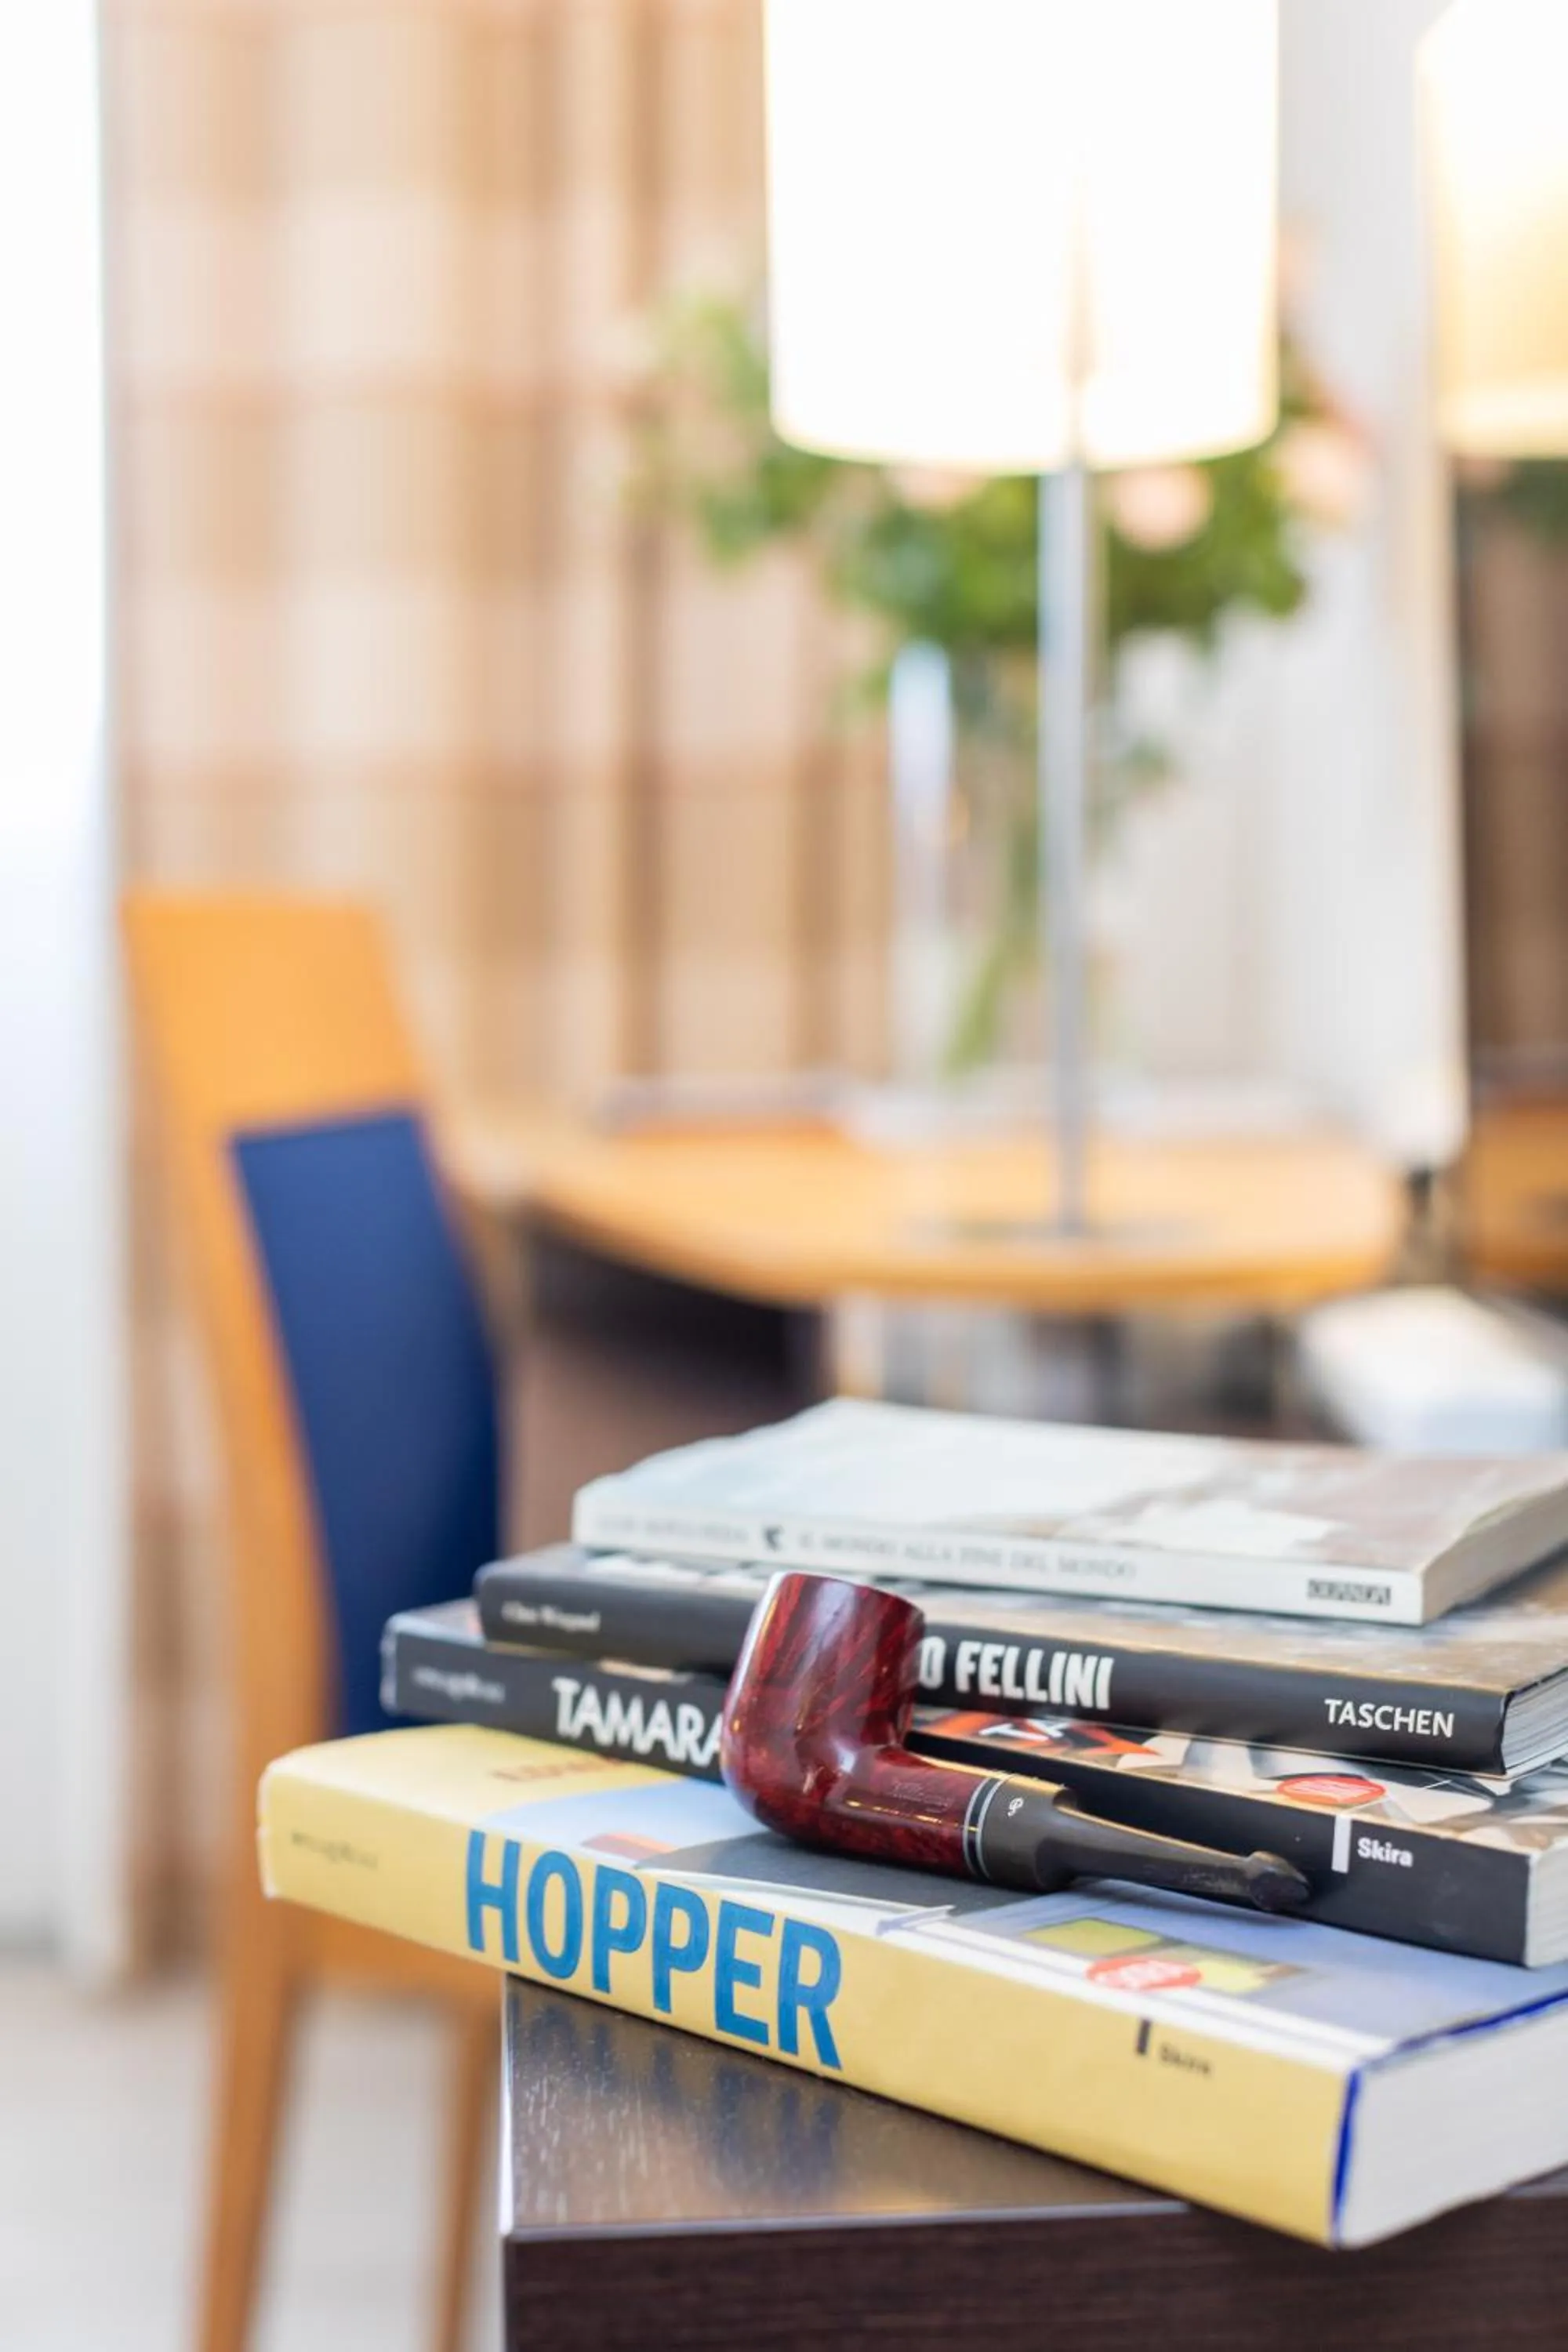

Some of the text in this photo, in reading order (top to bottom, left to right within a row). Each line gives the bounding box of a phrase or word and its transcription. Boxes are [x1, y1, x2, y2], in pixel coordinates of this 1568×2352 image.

[955, 1640, 1115, 1710] FELLINI
[1324, 1698, 1454, 1738] TASCHEN
[1357, 1837, 1414, 1867] Skira
[465, 1828, 843, 2071] HOPPER
